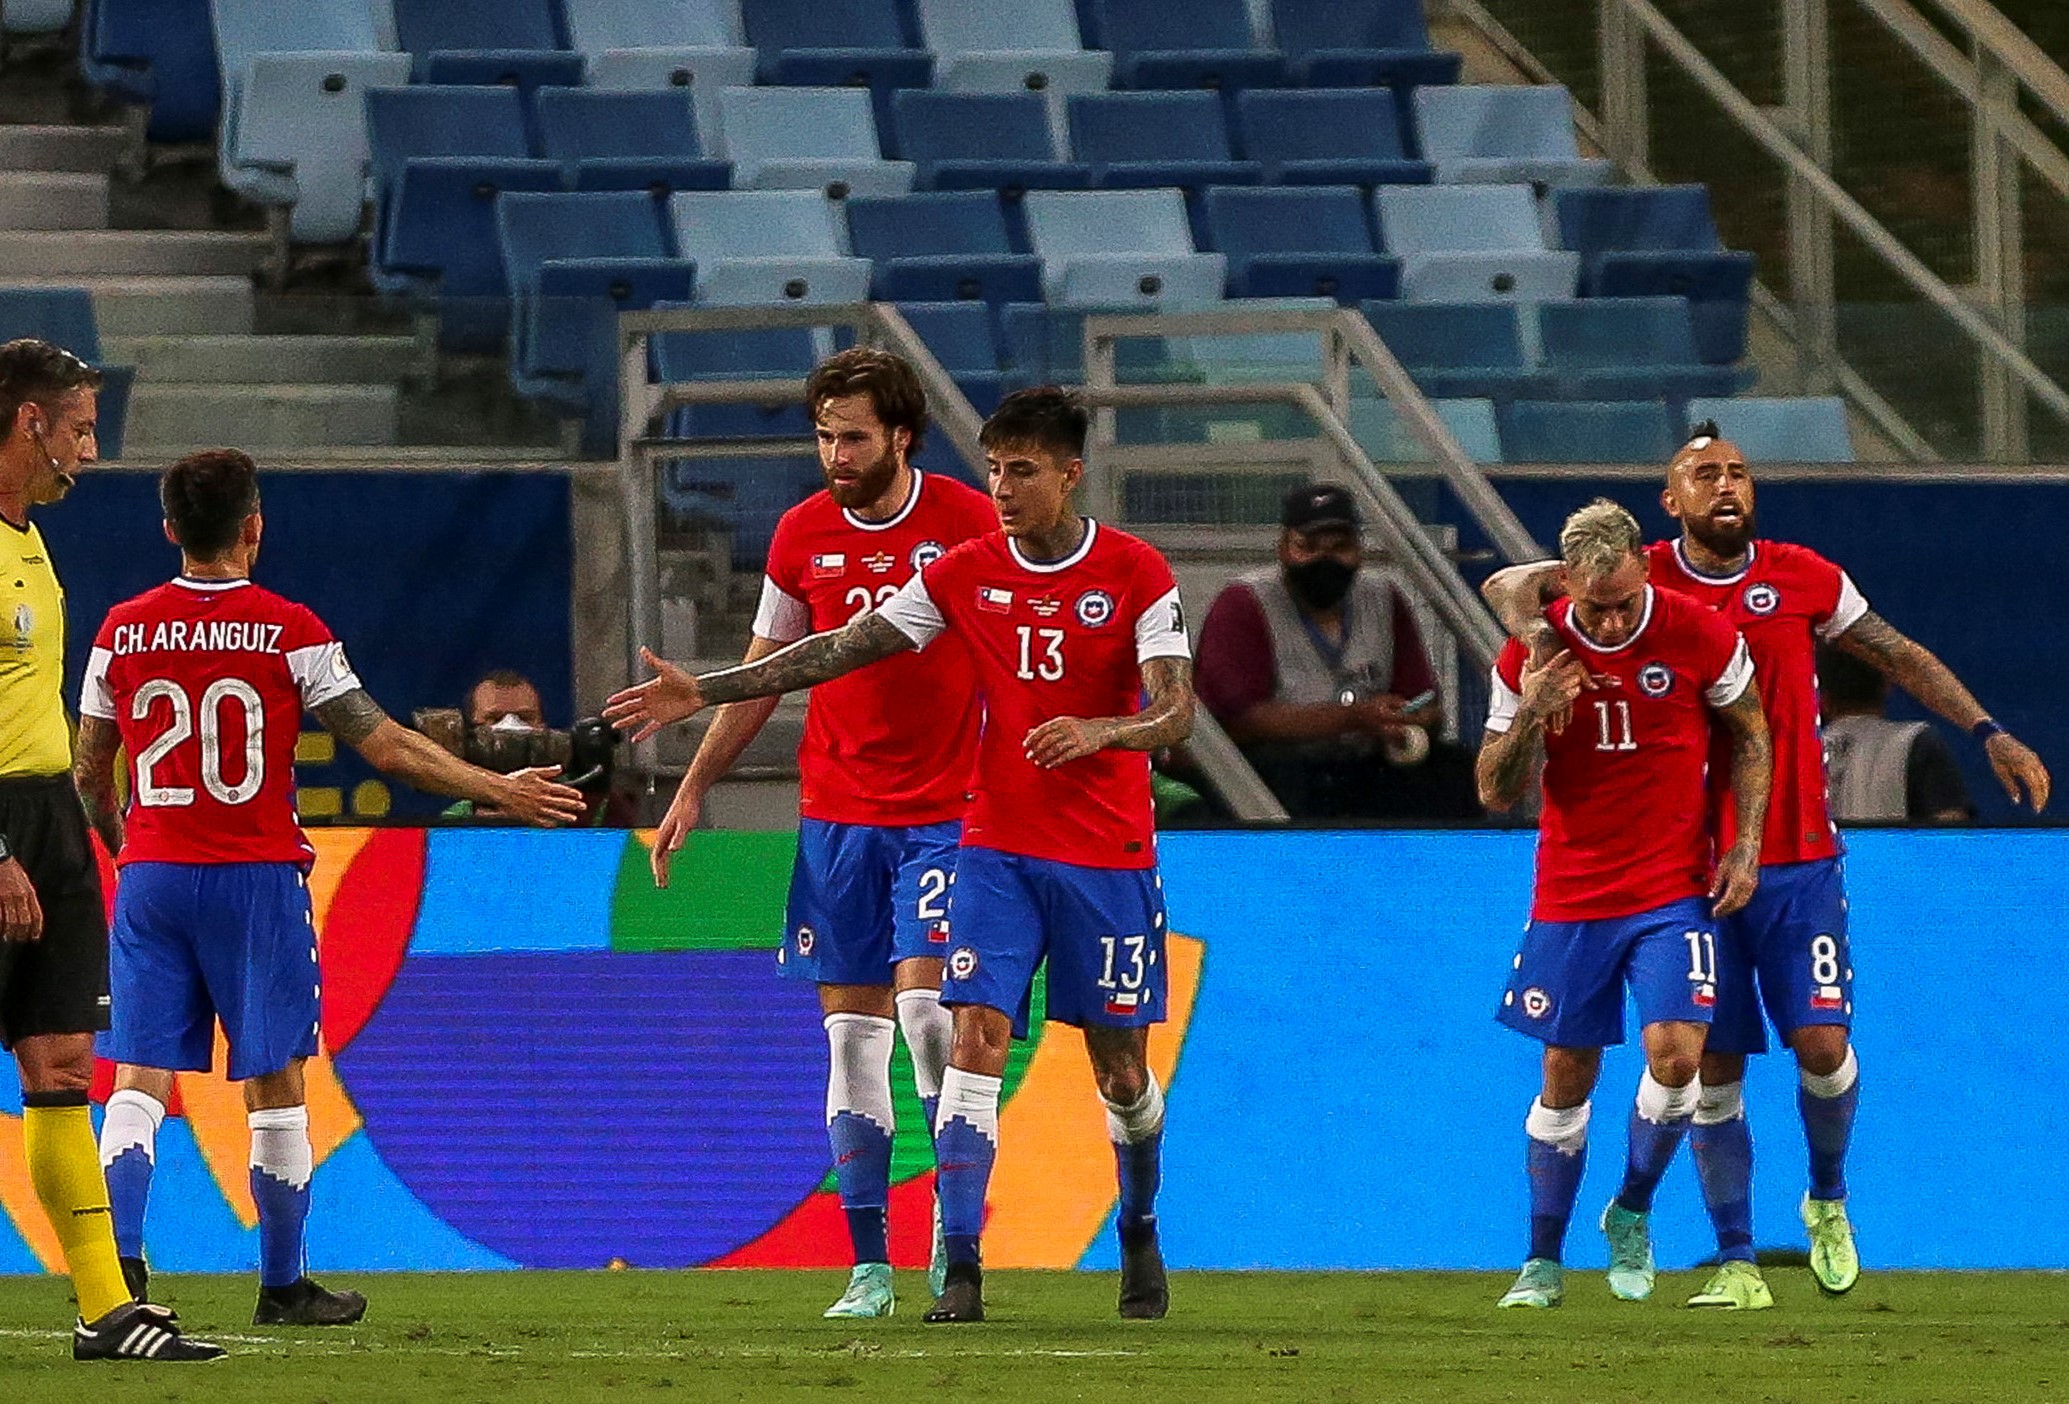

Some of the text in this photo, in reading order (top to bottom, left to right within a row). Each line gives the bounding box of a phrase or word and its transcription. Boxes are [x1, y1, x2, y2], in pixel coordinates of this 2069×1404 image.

[1016, 626, 1064, 680] 13
[132, 677, 264, 806] 20
[1593, 701, 1637, 751] 11
[1098, 936, 1145, 989] 13
[1684, 931, 1715, 983] 11
[1811, 934, 1838, 985] 8
